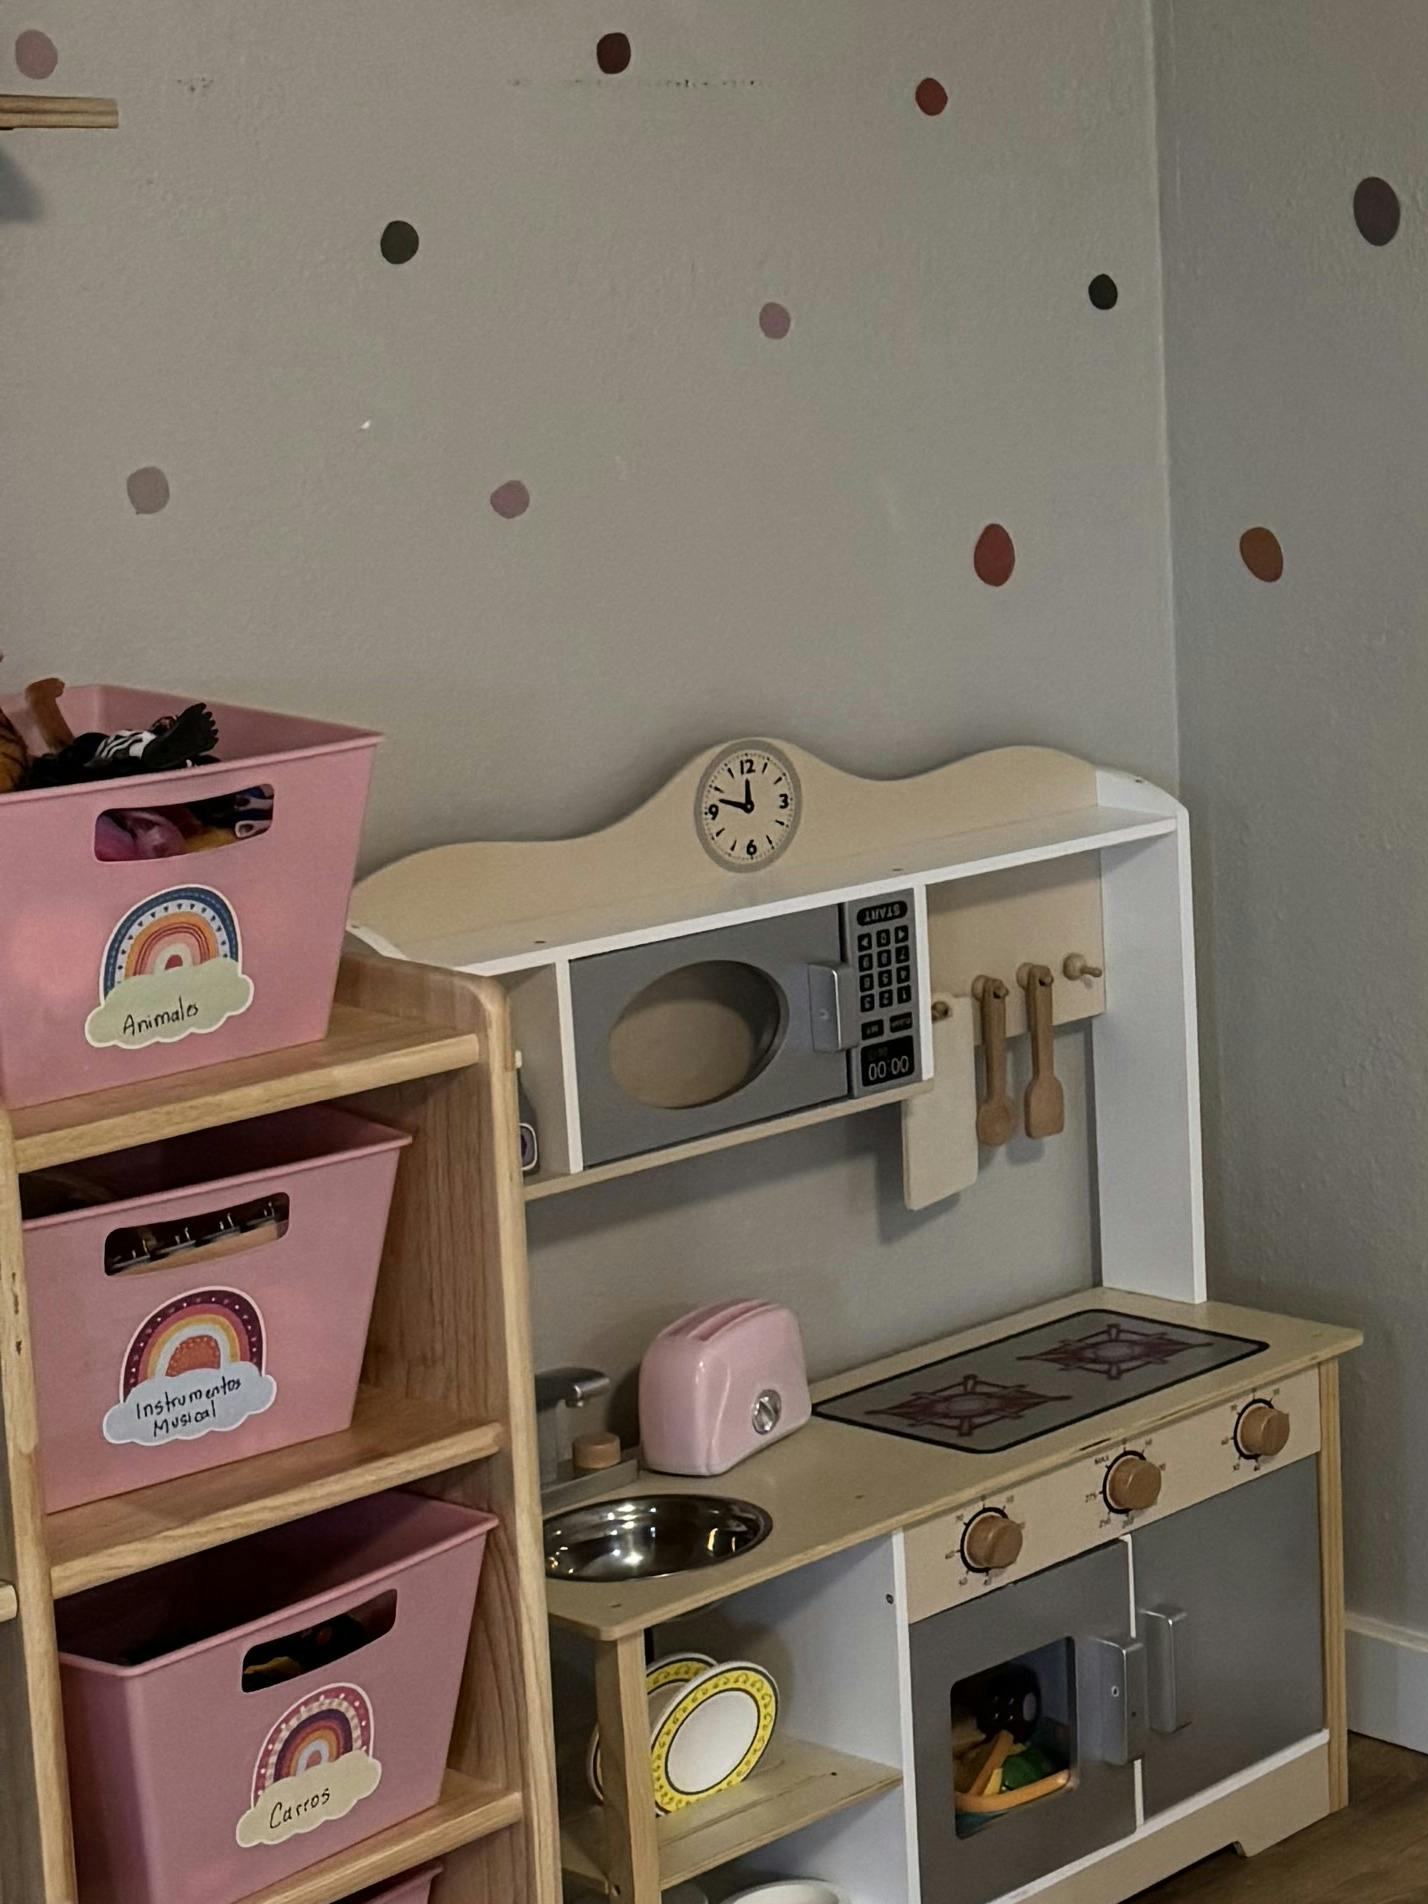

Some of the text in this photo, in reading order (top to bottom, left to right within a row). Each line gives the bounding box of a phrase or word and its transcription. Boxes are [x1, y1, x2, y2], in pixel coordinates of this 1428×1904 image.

[740, 759, 756, 775] 12
[708, 793, 789, 821] 9 3
[746, 839, 757, 856] 6
[864, 903, 901, 923] START
[136, 1375, 242, 1420] Instrumentos
[153, 1400, 217, 1437] Musical
[270, 1787, 331, 1829] Carros
